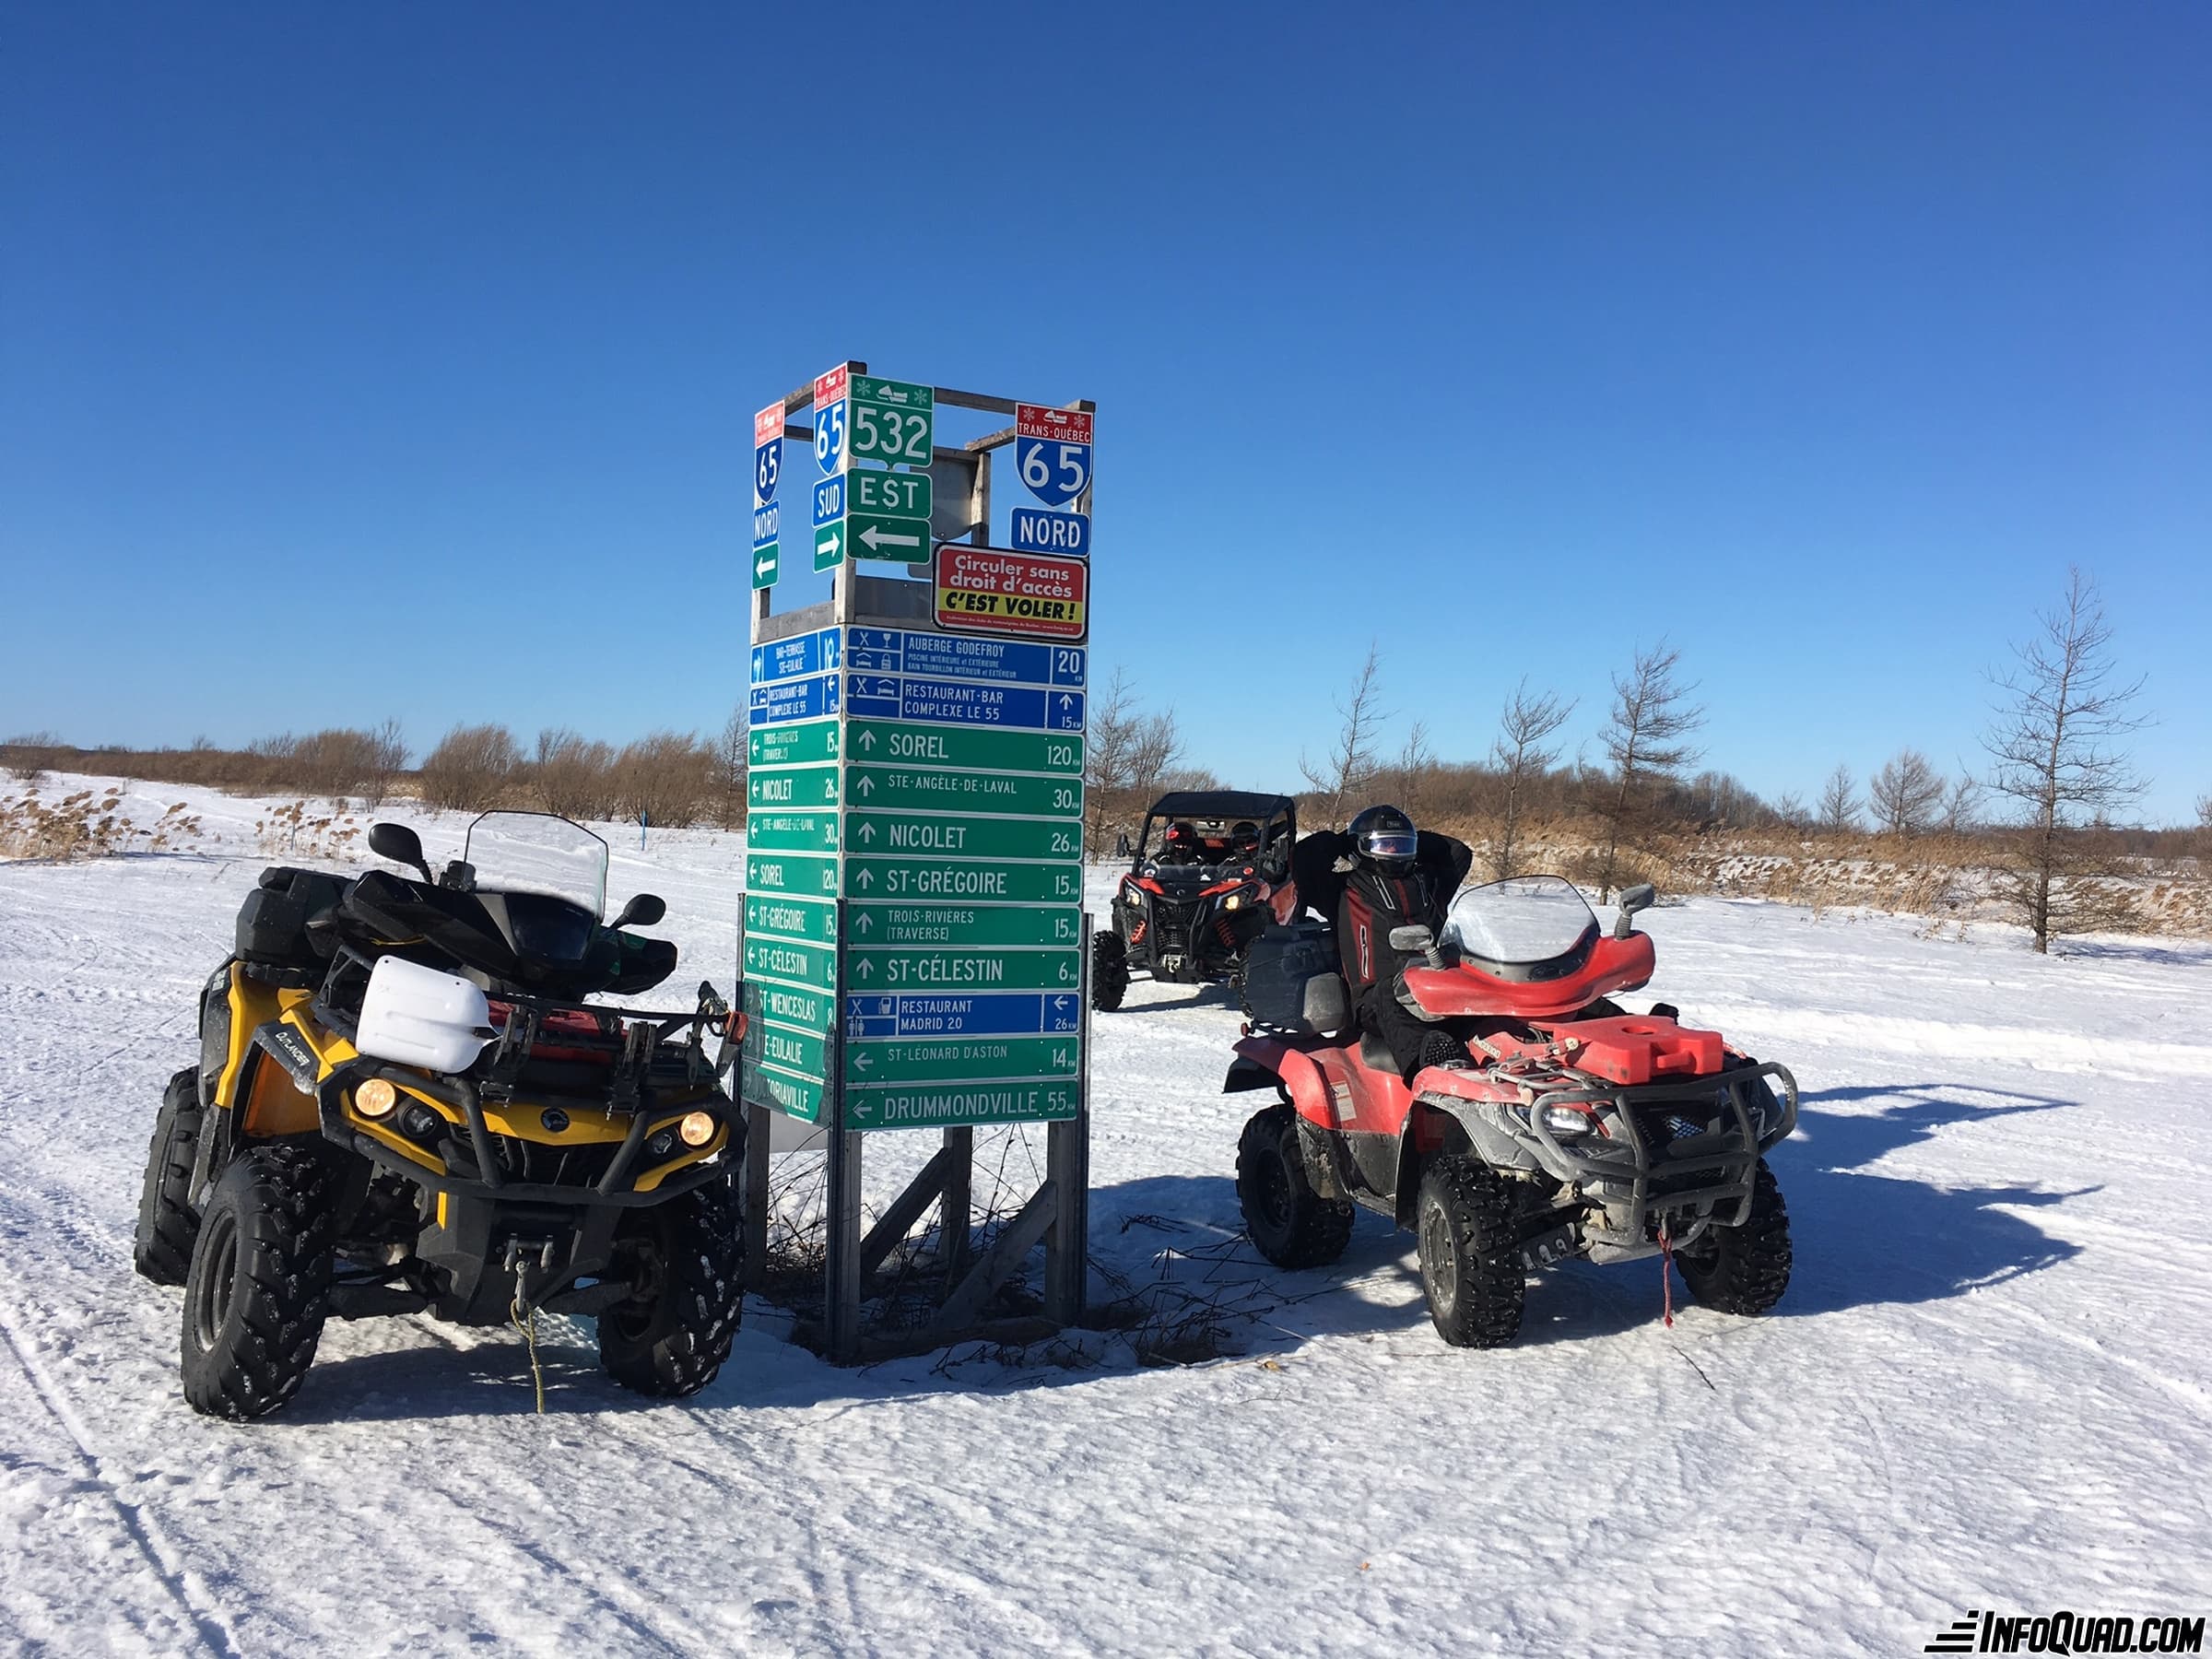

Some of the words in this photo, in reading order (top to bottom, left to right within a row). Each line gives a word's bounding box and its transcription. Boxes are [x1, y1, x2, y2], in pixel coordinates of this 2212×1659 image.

[817, 403, 844, 460] 65
[855, 406, 928, 460] 532
[1018, 422, 1090, 441] TRANS-QUÉBEC
[759, 445, 777, 488] 65
[1024, 442, 1085, 492] 65
[818, 485, 841, 519] SUD
[860, 477, 919, 510] EST
[754, 508, 779, 540] NORD
[1020, 515, 1081, 548] NORD
[955, 555, 1024, 576] Circuler
[1030, 567, 1070, 582] sans
[950, 571, 996, 590] droit
[1003, 577, 1073, 598] d'accès
[946, 592, 998, 613] C'EST
[909, 637, 952, 653] AUBERGE
[956, 641, 1005, 657] GODEFROY
[1058, 651, 1080, 675] 20
[905, 701, 963, 718] COMPLEXE
[968, 706, 981, 719] LE
[985, 707, 1000, 721] 55
[1062, 716, 1072, 727] 15
[827, 732, 835, 752] 15
[888, 734, 949, 759] SOREL
[1047, 745, 1071, 766] 120
[762, 779, 793, 800] NICOLET
[825, 778, 835, 798] 26
[1053, 790, 1072, 809] 30
[825, 824, 835, 843] 30
[889, 825, 966, 849] NICOLET
[1051, 833, 1070, 853] 26
[759, 864, 784, 886] SOREL
[823, 869, 835, 890] 120
[887, 866, 1007, 894] ST-GRÉGOIRE
[1054, 875, 1069, 895] 15
[759, 903, 806, 932] ST-GRÉGOIRE
[826, 915, 833, 935] 15
[888, 909, 974, 924] TROIS-RIVIÈRES
[1054, 918, 1069, 937] 15
[888, 925, 948, 941] (TRAVERSE)
[759, 947, 807, 976] ST-CÉLESTIN
[827, 963, 833, 982] 6
[887, 955, 1003, 982] ST-CÉLESTIN
[1059, 962, 1067, 981] 6
[901, 1000, 972, 1015] RESTAURANT
[901, 1017, 943, 1030] MADRID
[1054, 1018, 1067, 1030] 26
[276, 1031, 311, 1066] OUTLANDER
[759, 1031, 804, 1065] E-EULALIE
[888, 1046, 959, 1061] ST-LÉONARD
[964, 1046, 1007, 1060] D'ASTON
[1052, 1049, 1066, 1067] 14
[884, 1091, 1038, 1120] DRUMMONDVILLE
[1047, 1091, 1066, 1111] 55
